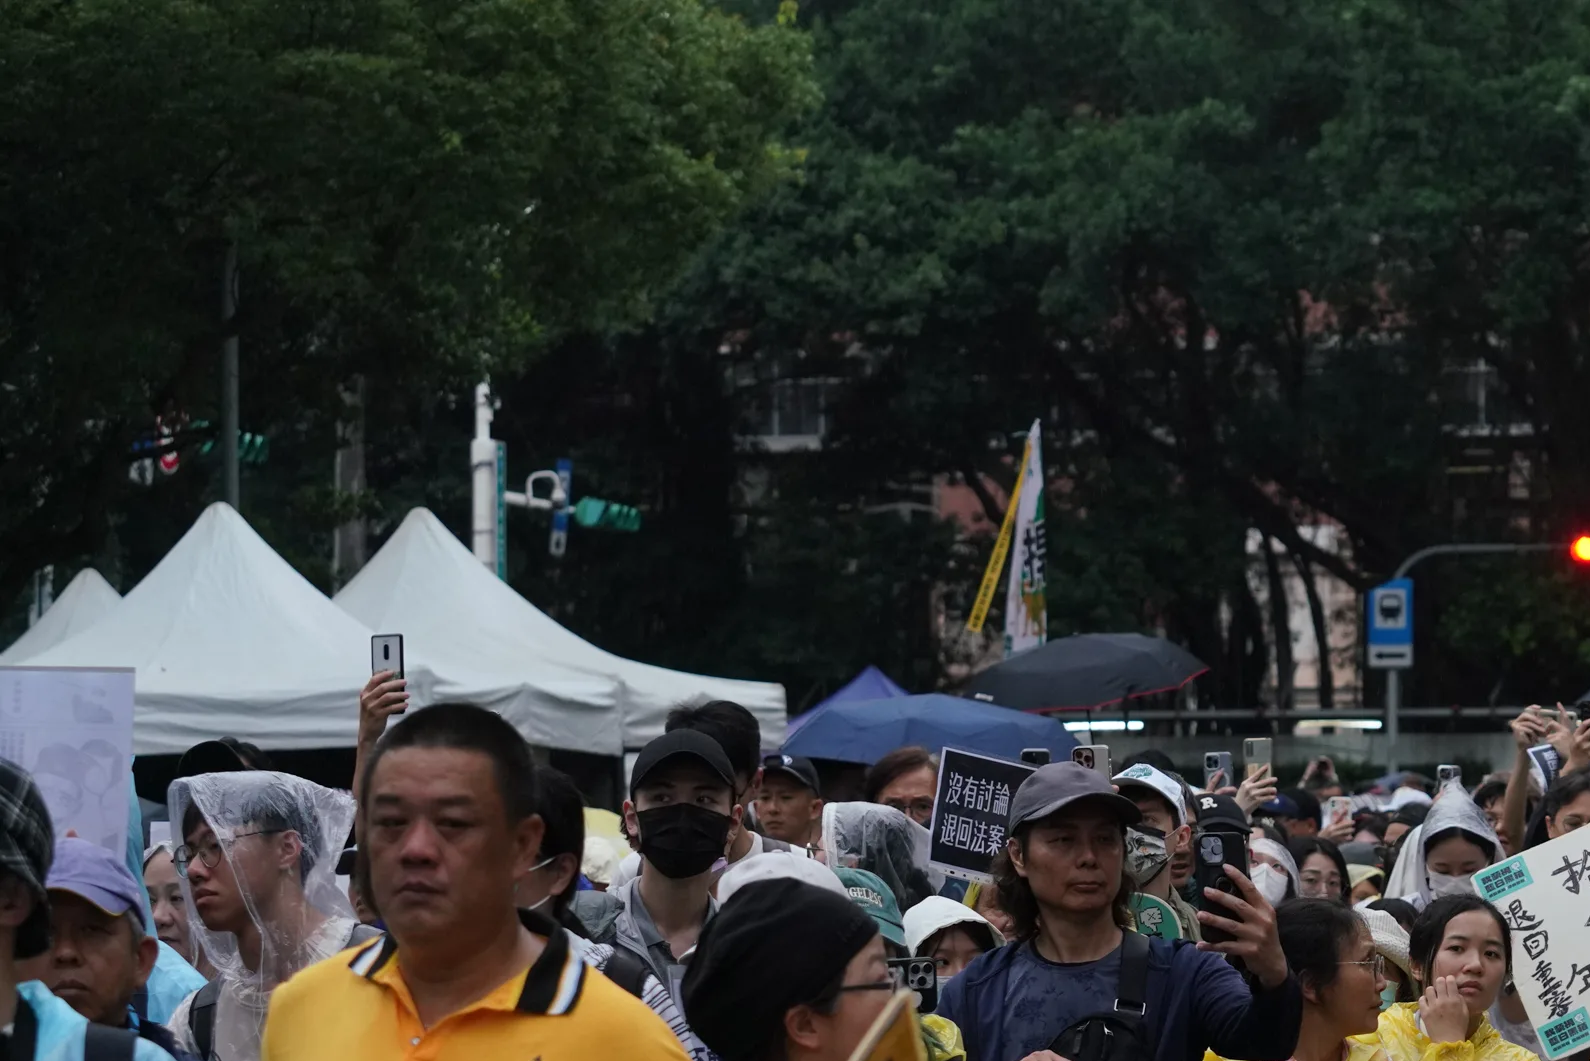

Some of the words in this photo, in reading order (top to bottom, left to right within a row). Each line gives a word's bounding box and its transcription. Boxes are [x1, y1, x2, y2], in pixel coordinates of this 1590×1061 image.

[946, 772, 1010, 816] 沒有討論
[1201, 797, 1218, 810] R
